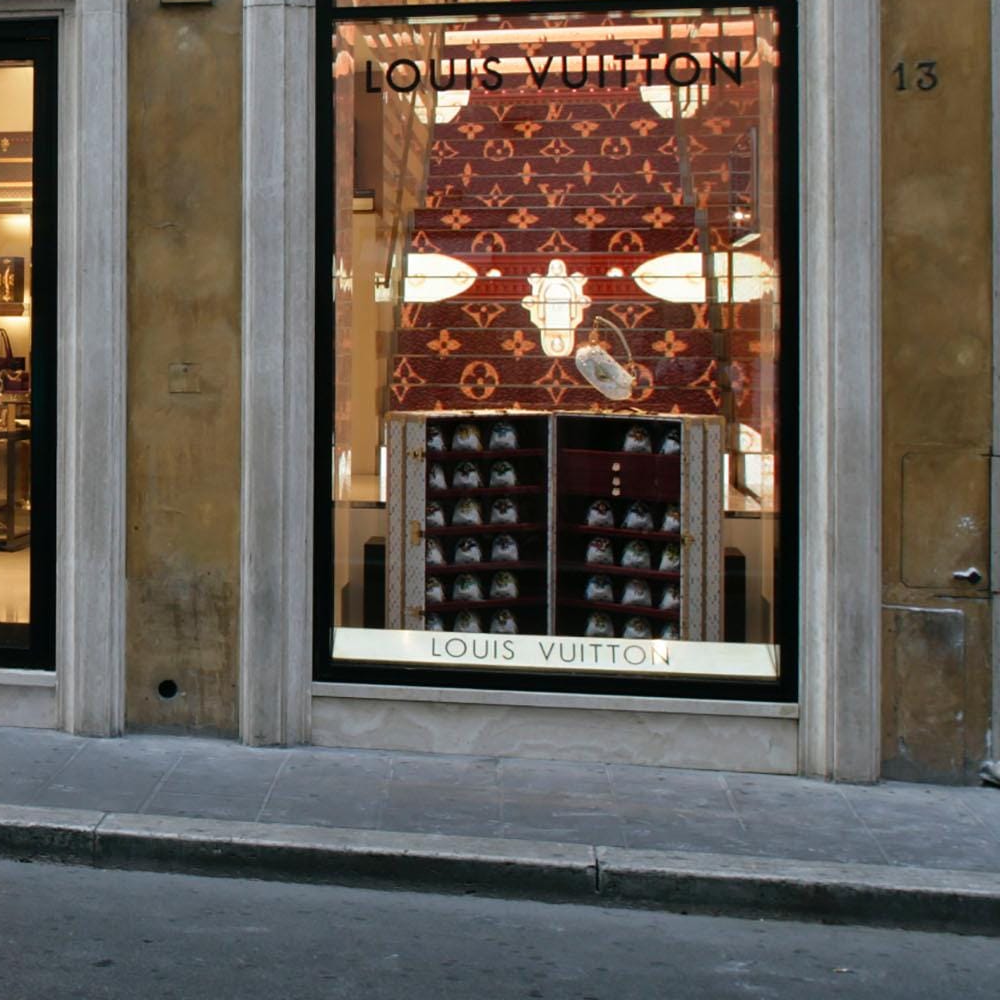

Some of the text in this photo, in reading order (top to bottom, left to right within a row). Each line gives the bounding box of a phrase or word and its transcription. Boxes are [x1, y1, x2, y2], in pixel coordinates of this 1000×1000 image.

[366, 51, 743, 93] LOUIS VUITTON
[892, 61, 939, 91] 13
[431, 637, 671, 666] LOUIS VUITTON
